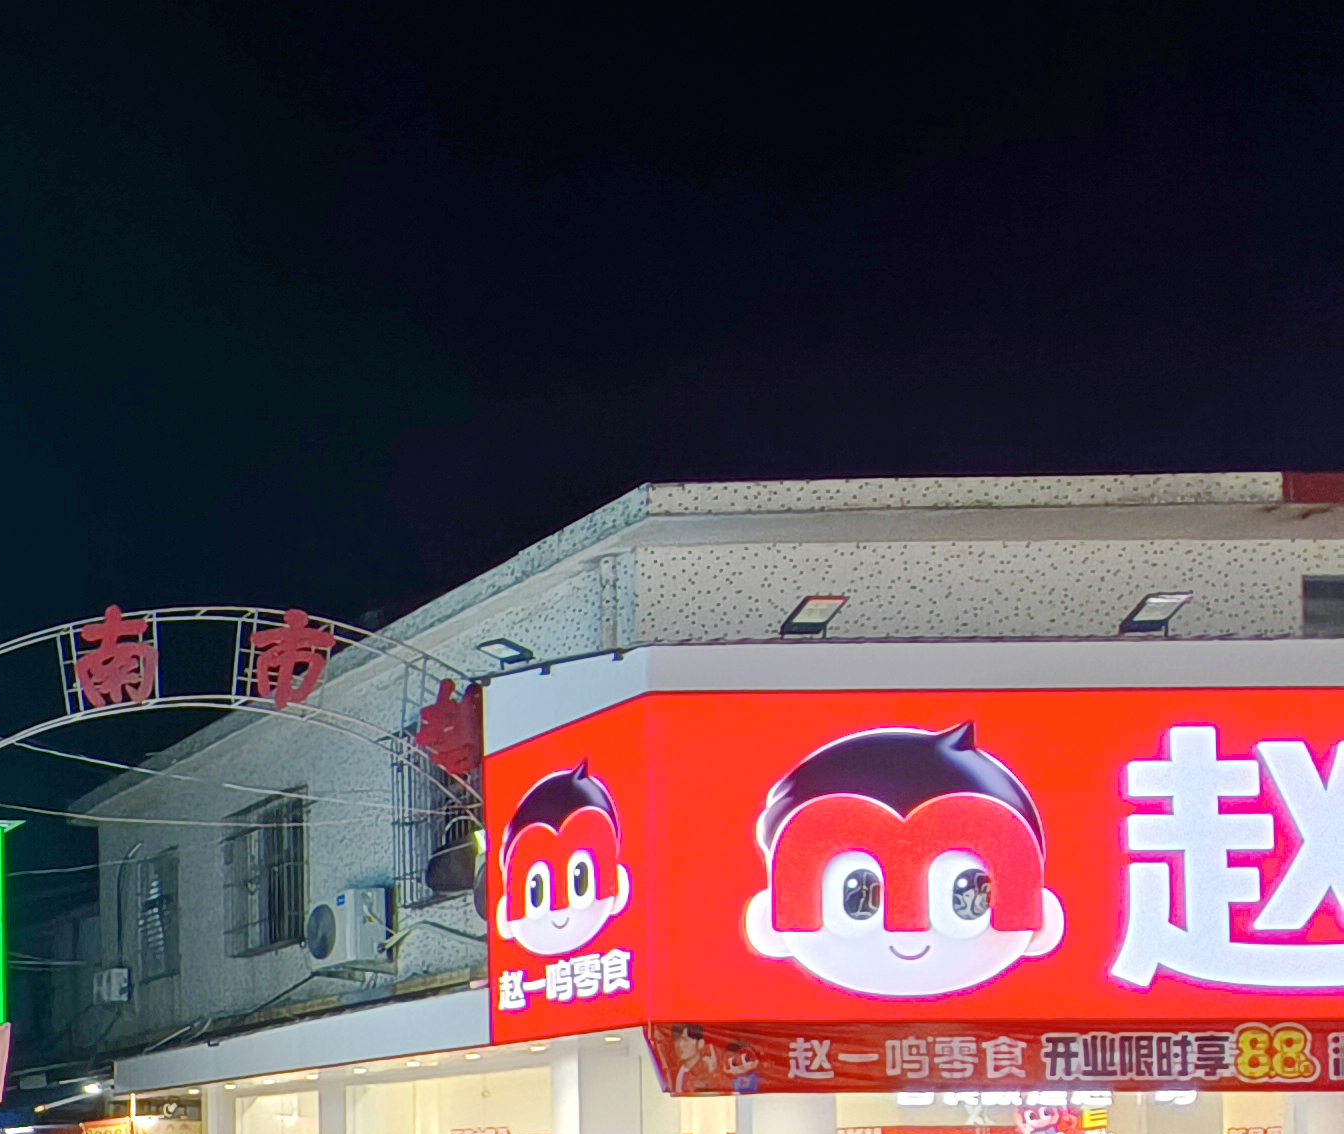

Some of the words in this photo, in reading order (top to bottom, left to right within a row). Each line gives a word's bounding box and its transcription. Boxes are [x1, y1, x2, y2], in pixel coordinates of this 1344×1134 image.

[497, 948, 632, 1012] 赵一鸣零食
[787, 1036, 1026, 1080] 赵一鸣零食
